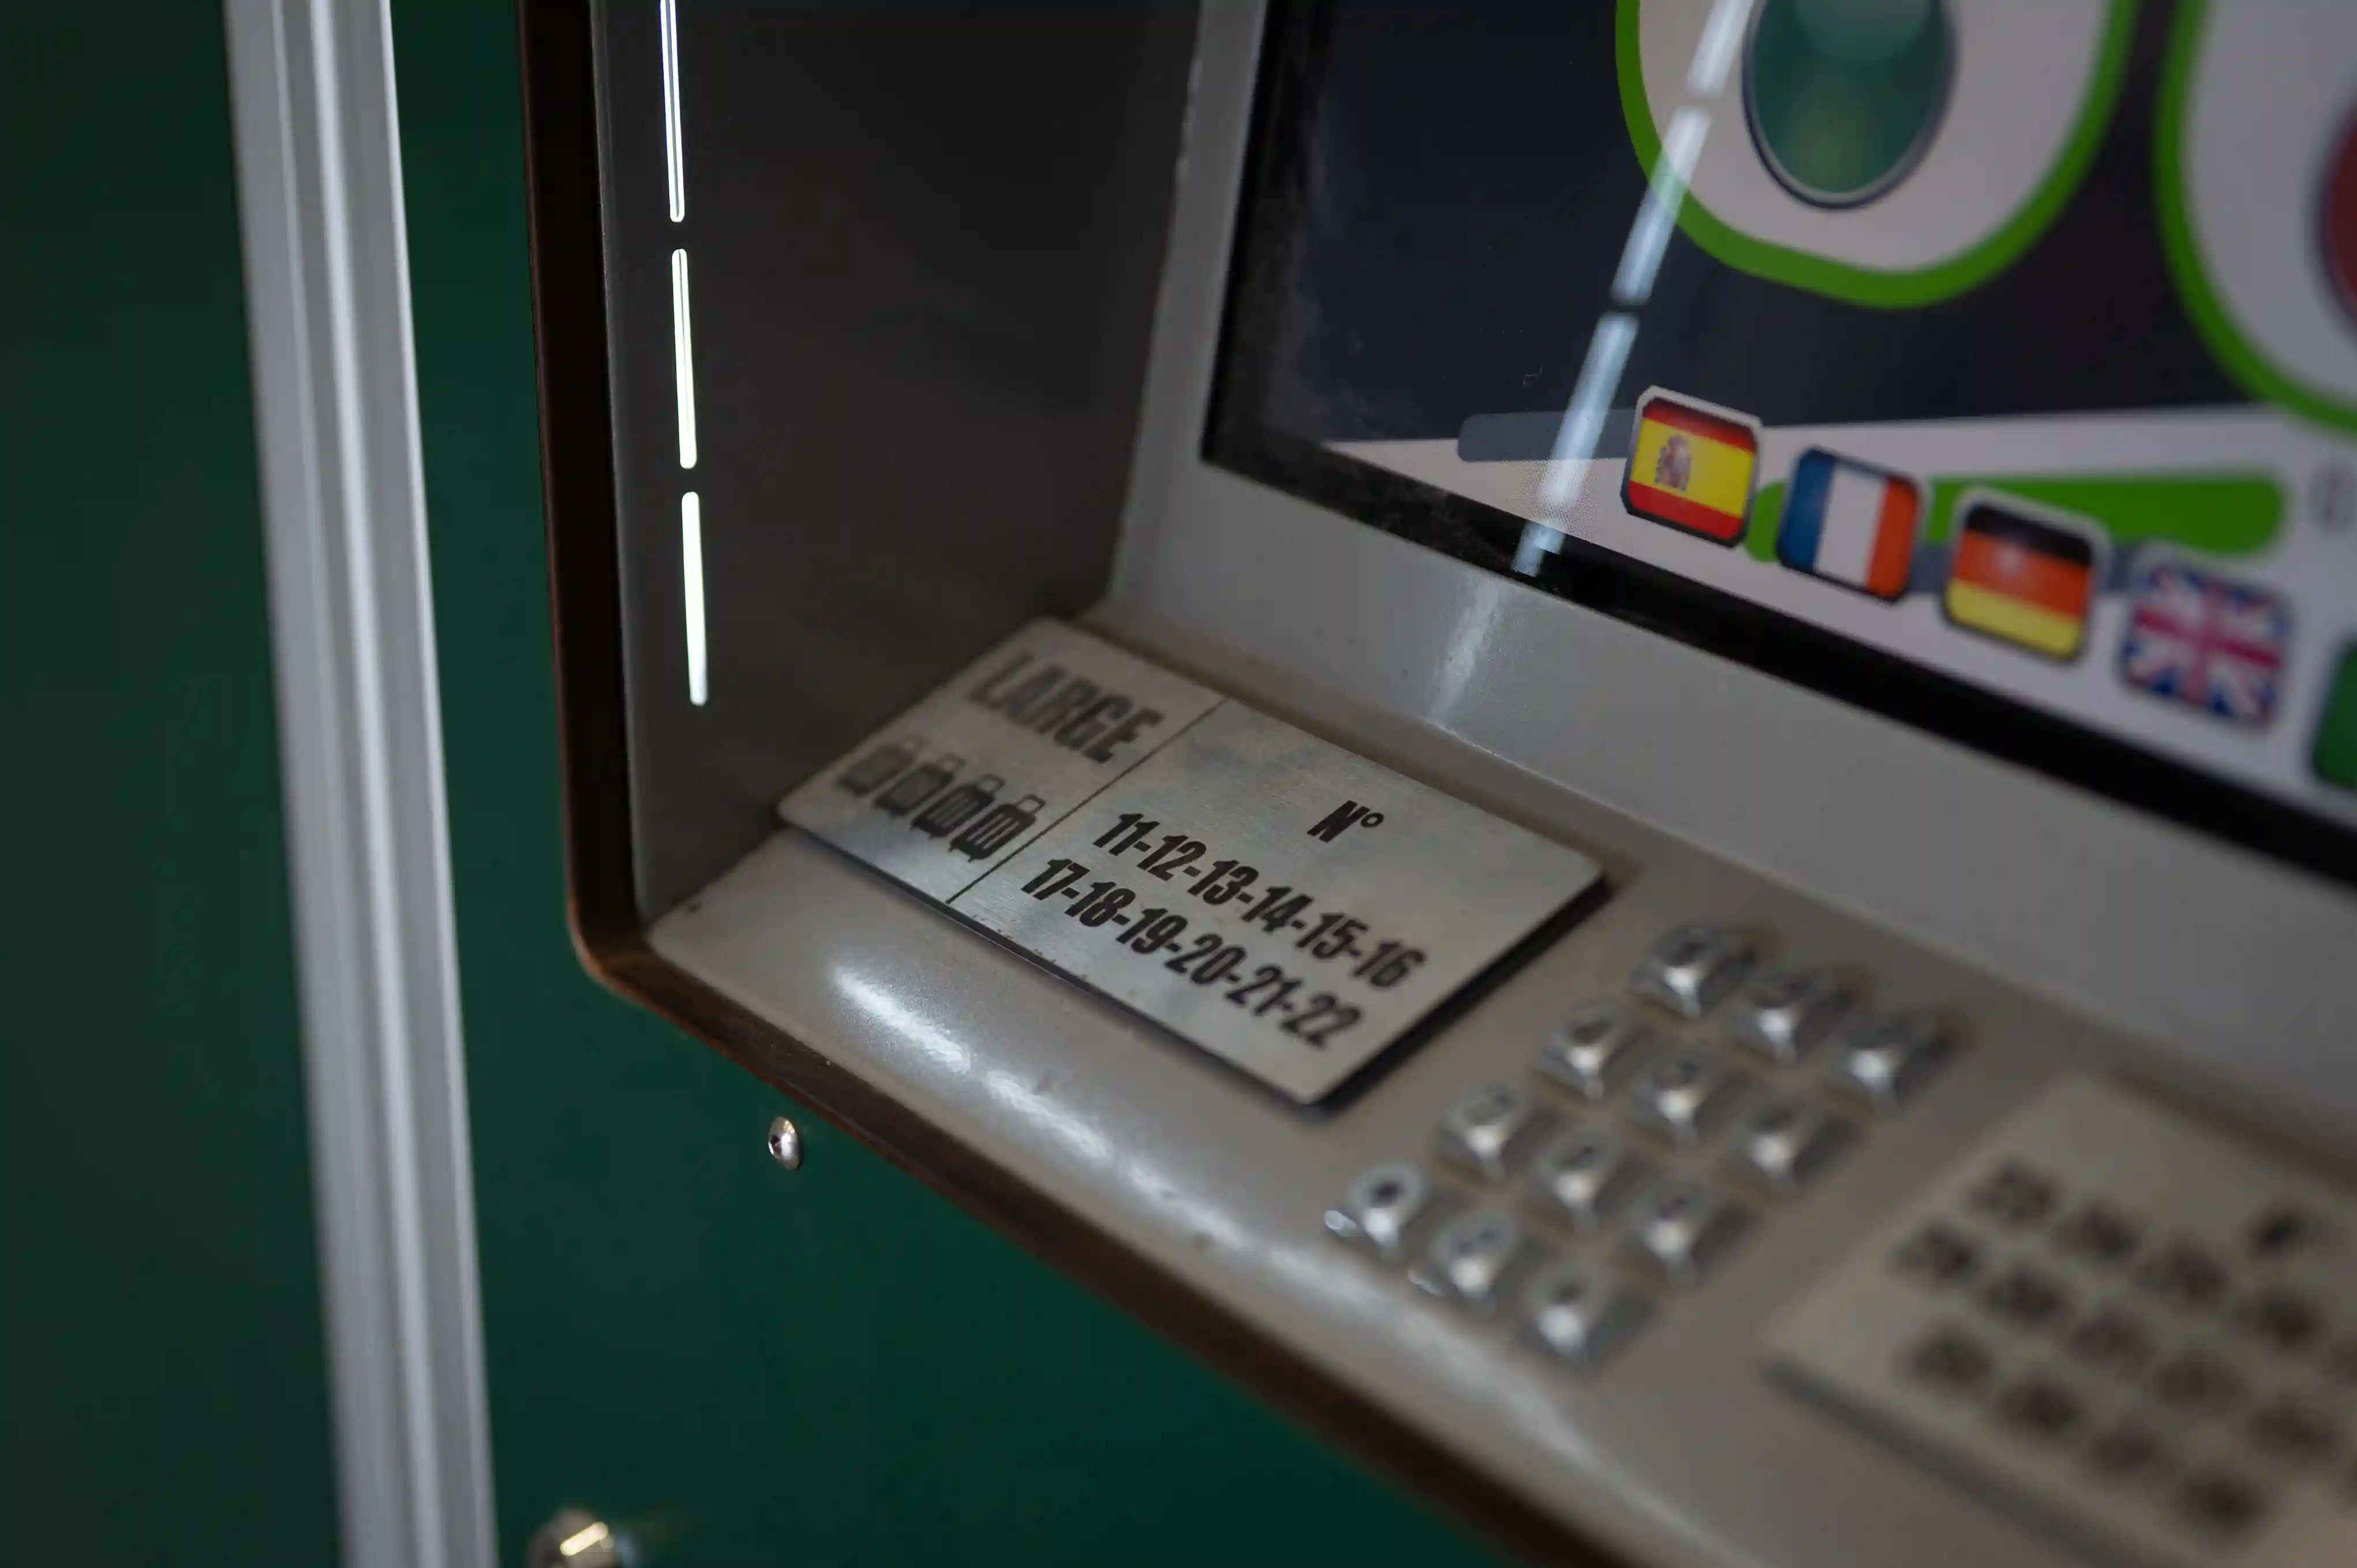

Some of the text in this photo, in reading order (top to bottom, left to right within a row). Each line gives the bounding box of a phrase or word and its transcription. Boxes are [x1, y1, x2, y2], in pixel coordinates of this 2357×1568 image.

[968, 650, 1165, 764] LARGE
[1020, 859, 1364, 1049] 17-18-19-20-21-22
[1093, 813, 1427, 989] 11-12-13-14-15-16
